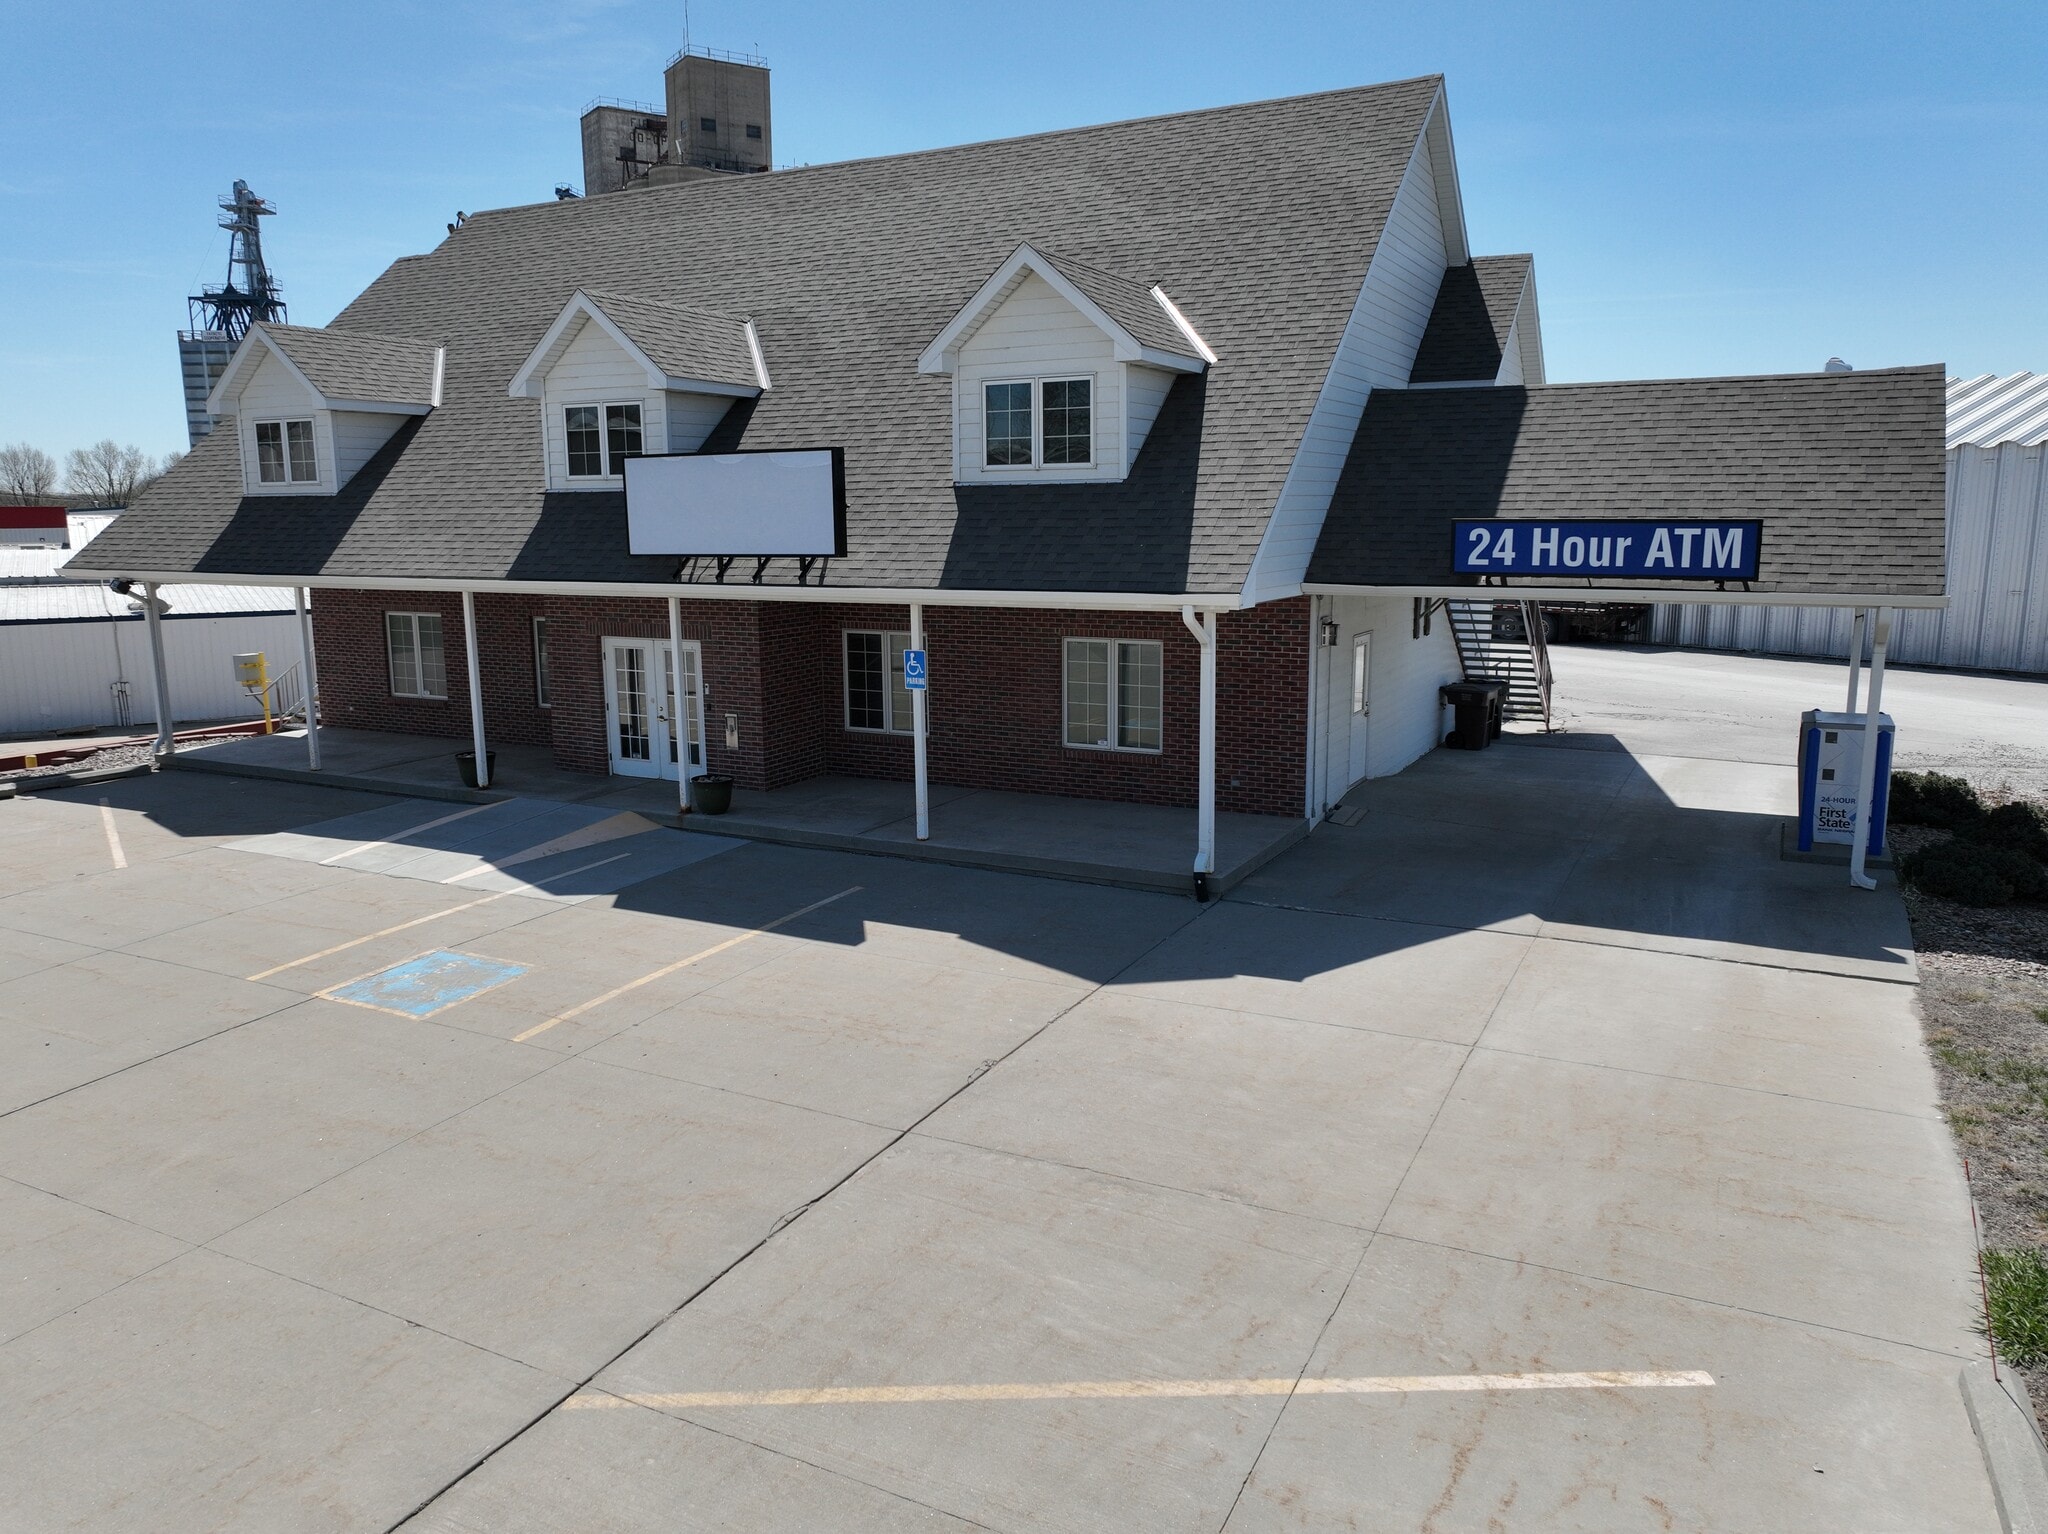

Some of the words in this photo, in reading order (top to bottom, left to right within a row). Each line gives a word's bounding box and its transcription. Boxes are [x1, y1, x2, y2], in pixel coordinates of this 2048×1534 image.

[1467, 527, 1516, 567] 24
[1531, 527, 1632, 568] Hour
[1644, 527, 1744, 569] ATM
[906, 677, 925, 685] PARKING
[1821, 796, 1856, 805] 24-HOUR
[1819, 806, 1847, 818] First
[1818, 817, 1850, 829] State
